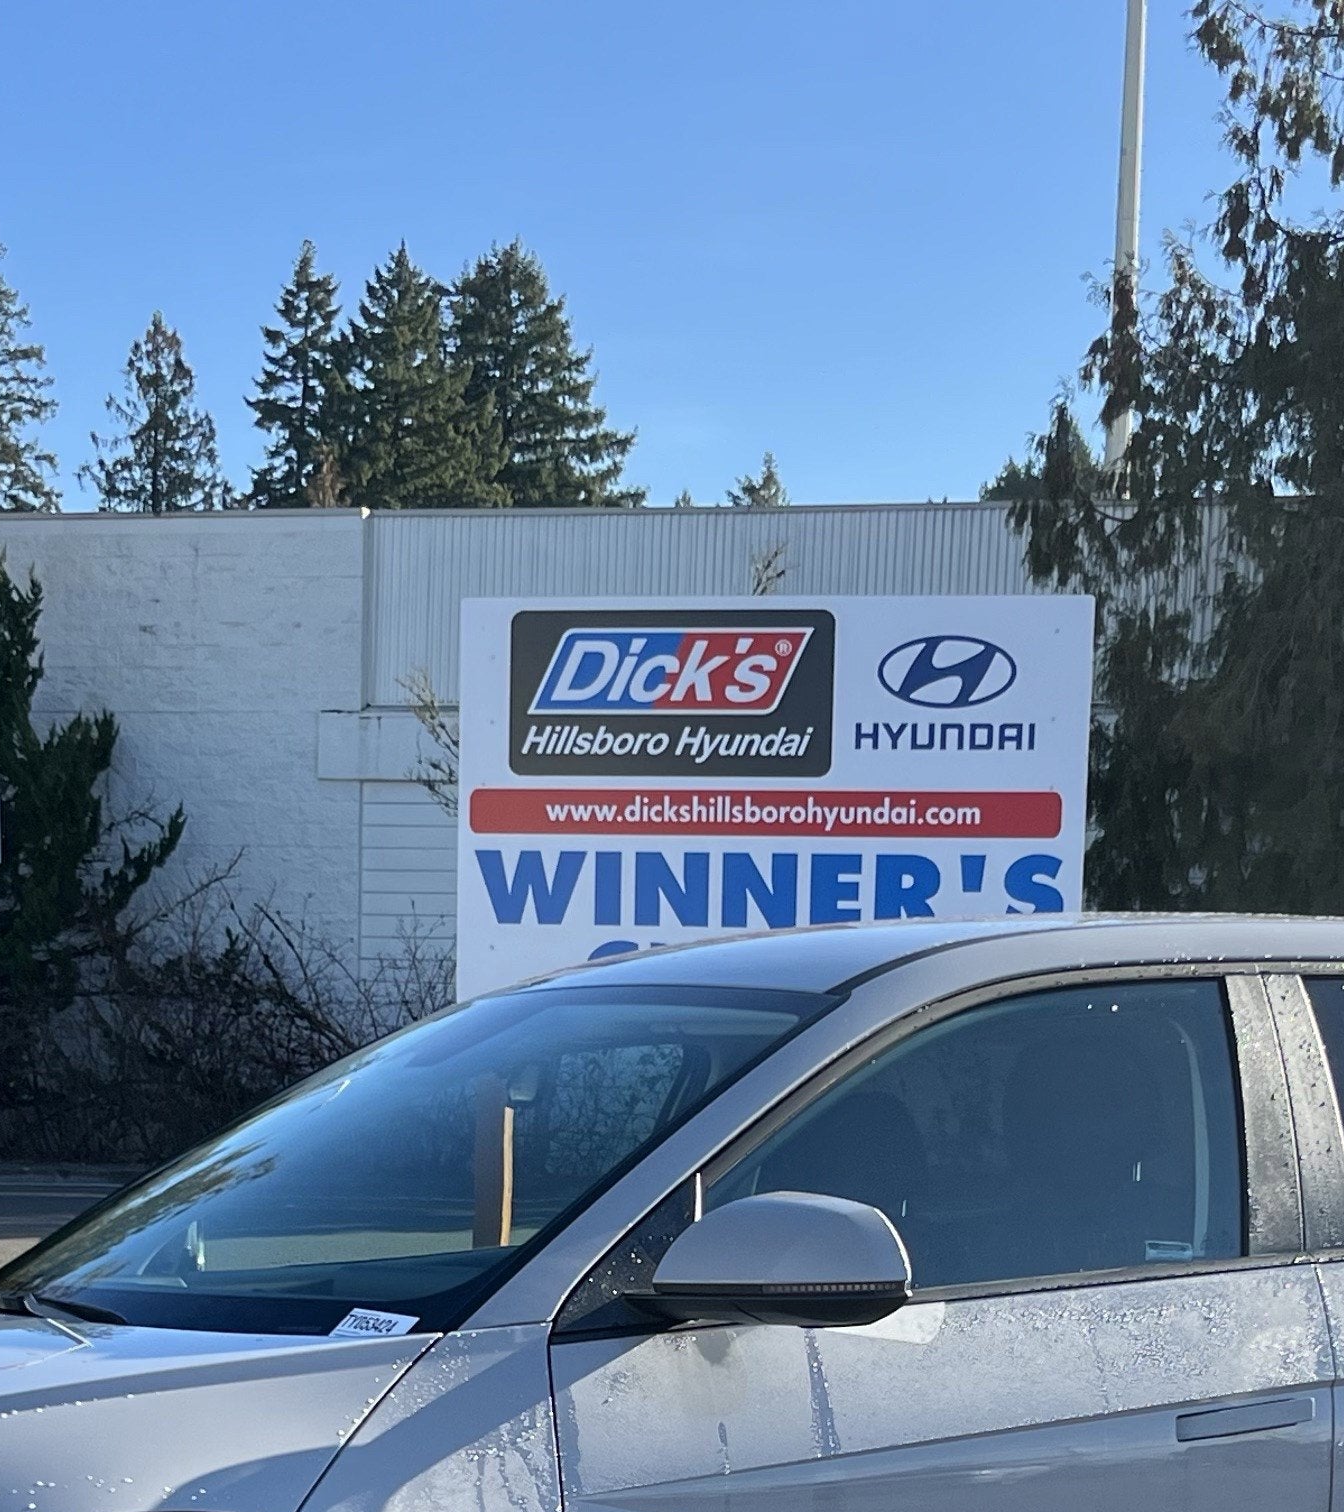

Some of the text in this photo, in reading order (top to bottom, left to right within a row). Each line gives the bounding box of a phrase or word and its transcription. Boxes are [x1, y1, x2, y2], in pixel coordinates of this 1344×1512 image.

[550, 637, 778, 704] Dick's
[521, 725, 814, 764] Hillsboro Hyundai
[856, 722, 1036, 751] HYUNDAI
[546, 796, 981, 832] www.dickshillsborohyundai.com
[475, 850, 1064, 928] WINNER'S
